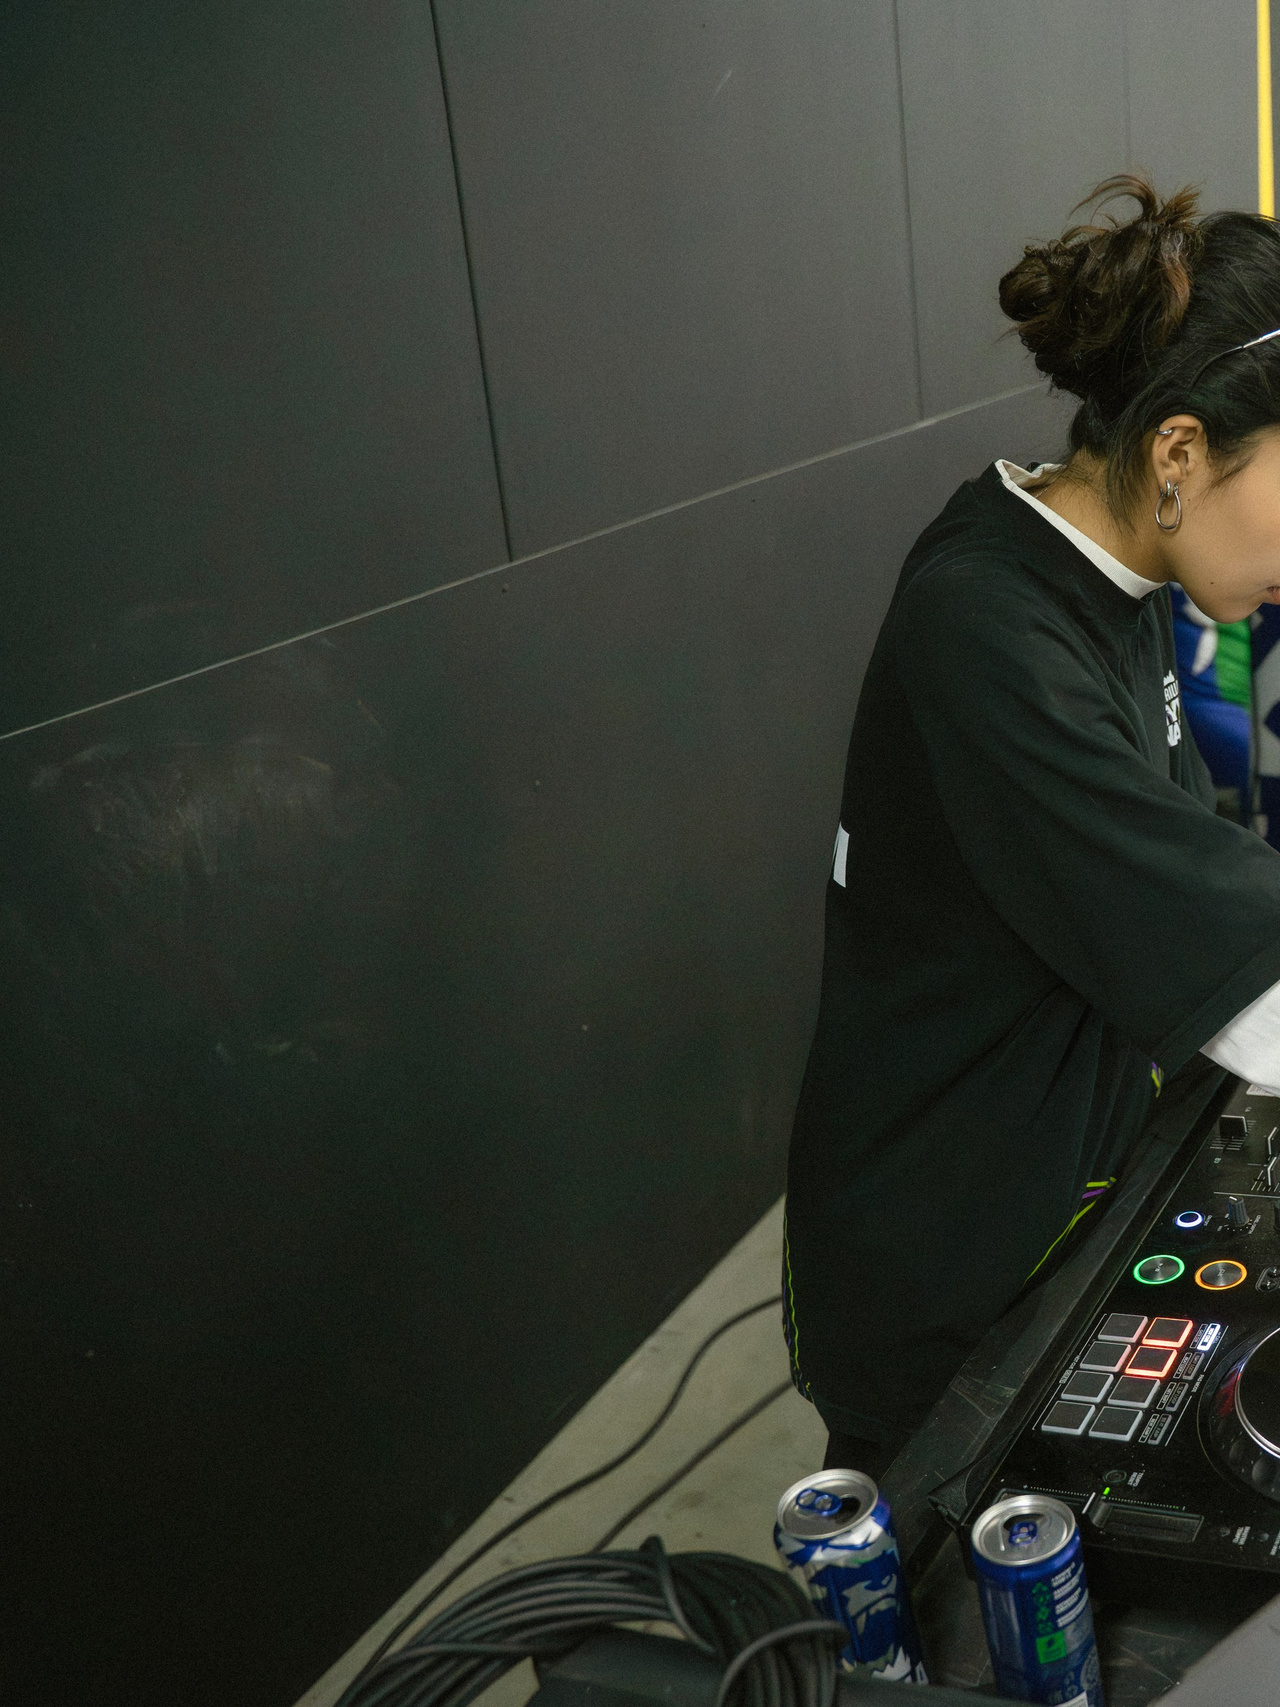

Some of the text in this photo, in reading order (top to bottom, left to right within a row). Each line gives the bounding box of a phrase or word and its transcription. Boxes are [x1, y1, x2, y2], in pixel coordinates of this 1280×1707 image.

[1191, 1382, 1200, 1393] MODE
[1127, 1472, 1138, 1486] RESET
[1132, 1472, 1144, 1488] TEMPO
